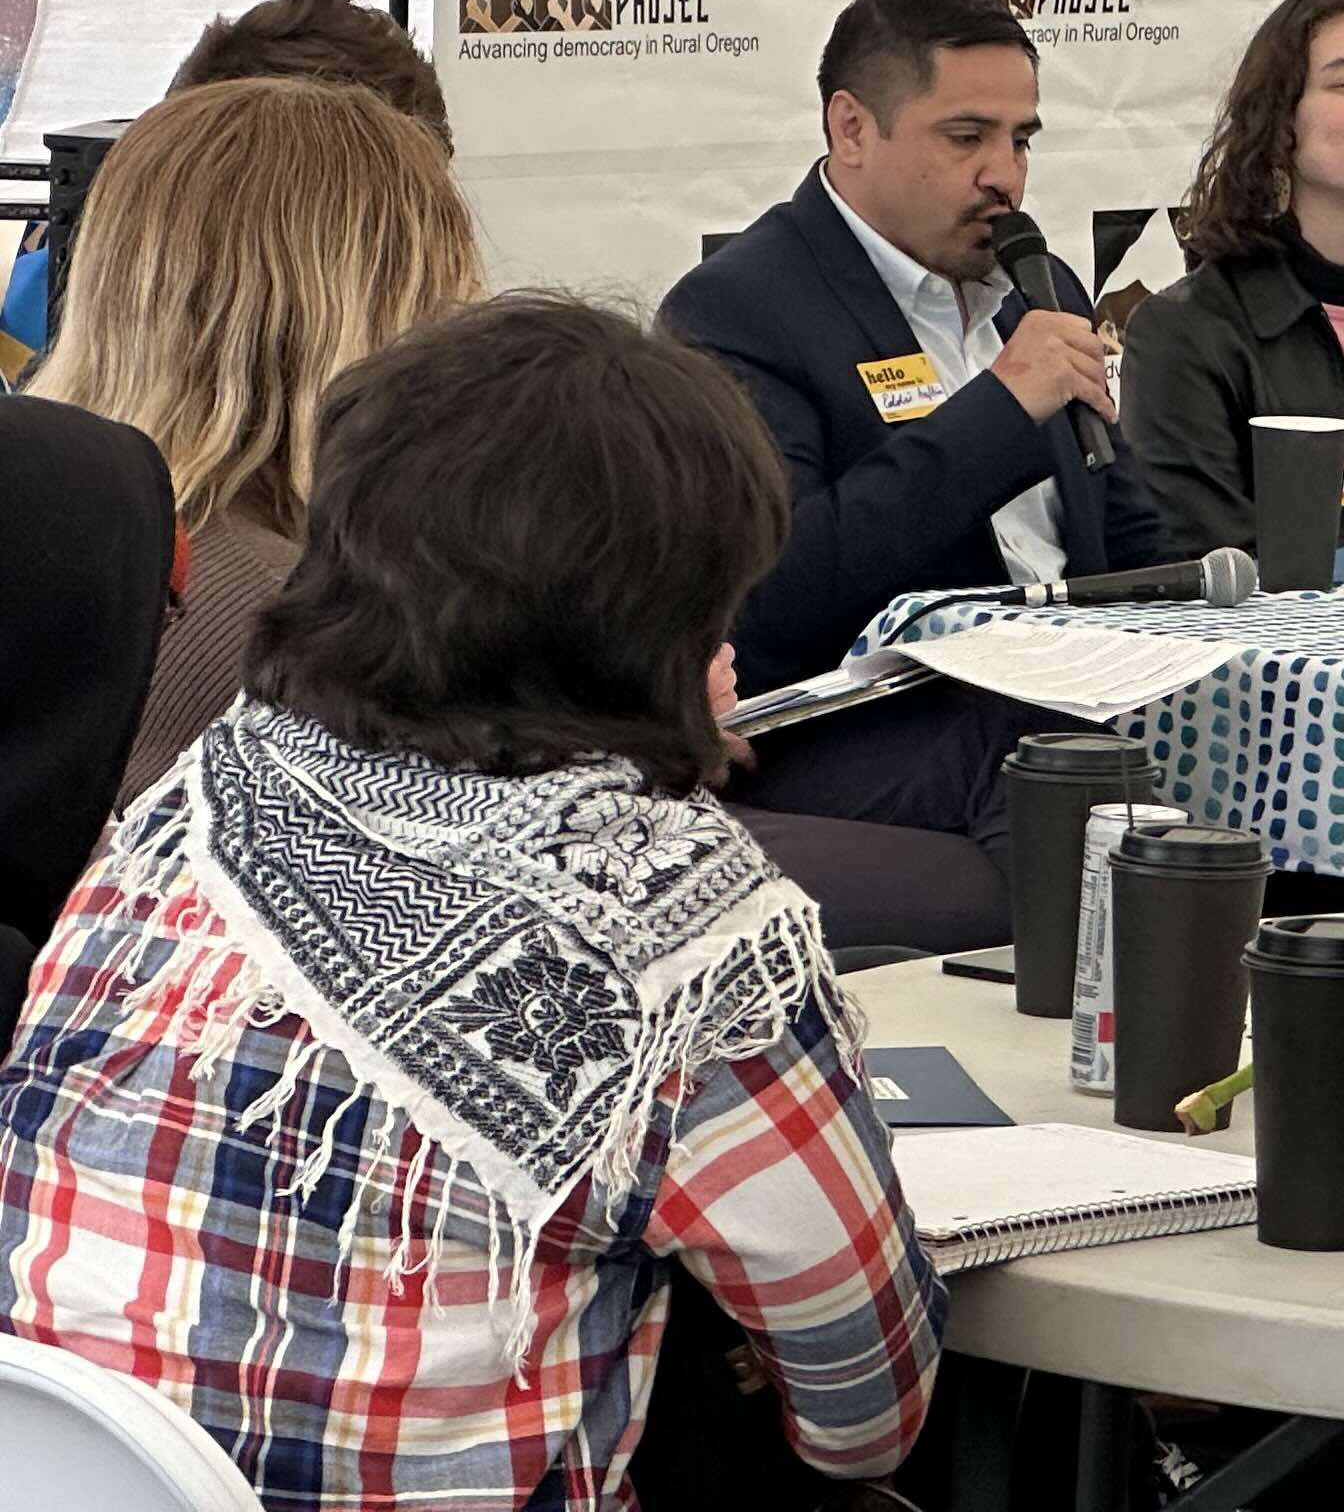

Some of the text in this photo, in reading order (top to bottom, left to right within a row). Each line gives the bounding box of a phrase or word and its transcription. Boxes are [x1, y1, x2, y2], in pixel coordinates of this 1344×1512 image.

[459, 33, 758, 63] Advancing democracy in Rural Oregon
[1025, 22, 1179, 48] cracy in Rural Oregon
[866, 367, 905, 385] hello
